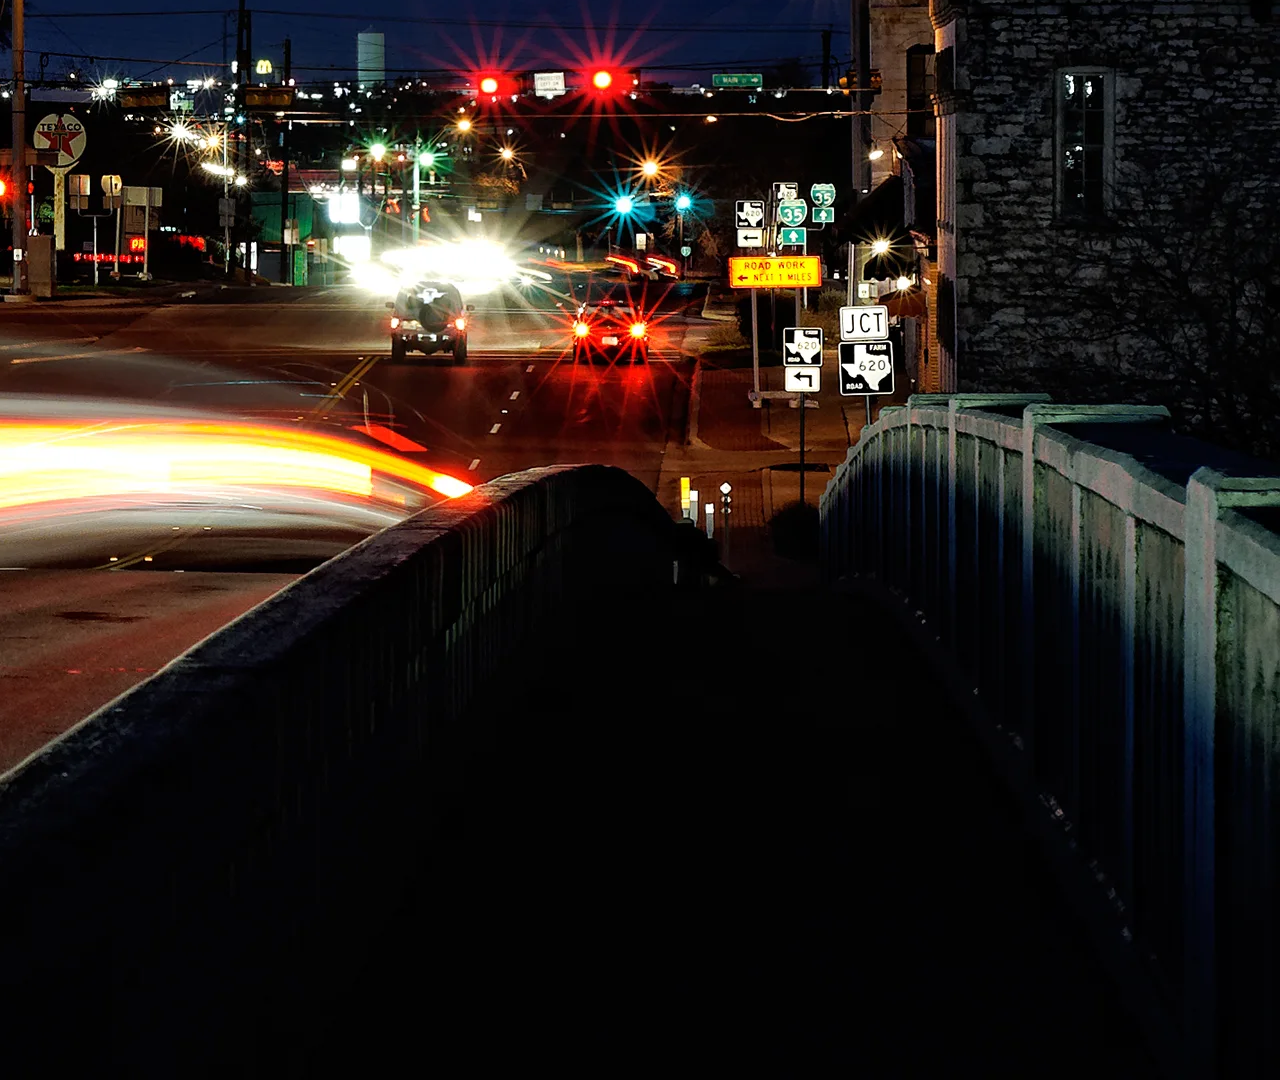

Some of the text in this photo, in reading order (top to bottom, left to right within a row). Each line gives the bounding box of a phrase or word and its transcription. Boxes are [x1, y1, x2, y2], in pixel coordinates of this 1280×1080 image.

[722, 76, 738, 84] MAIN
[40, 123, 82, 131] TEXACO
[815, 192, 832, 204] 35
[784, 208, 803, 222] 35
[744, 261, 806, 270] ROAD WORK
[754, 273, 774, 282] NEXT
[788, 272, 812, 281] MILES
[846, 312, 884, 334] JCT
[797, 342, 817, 350] 620
[859, 360, 886, 372] 620
